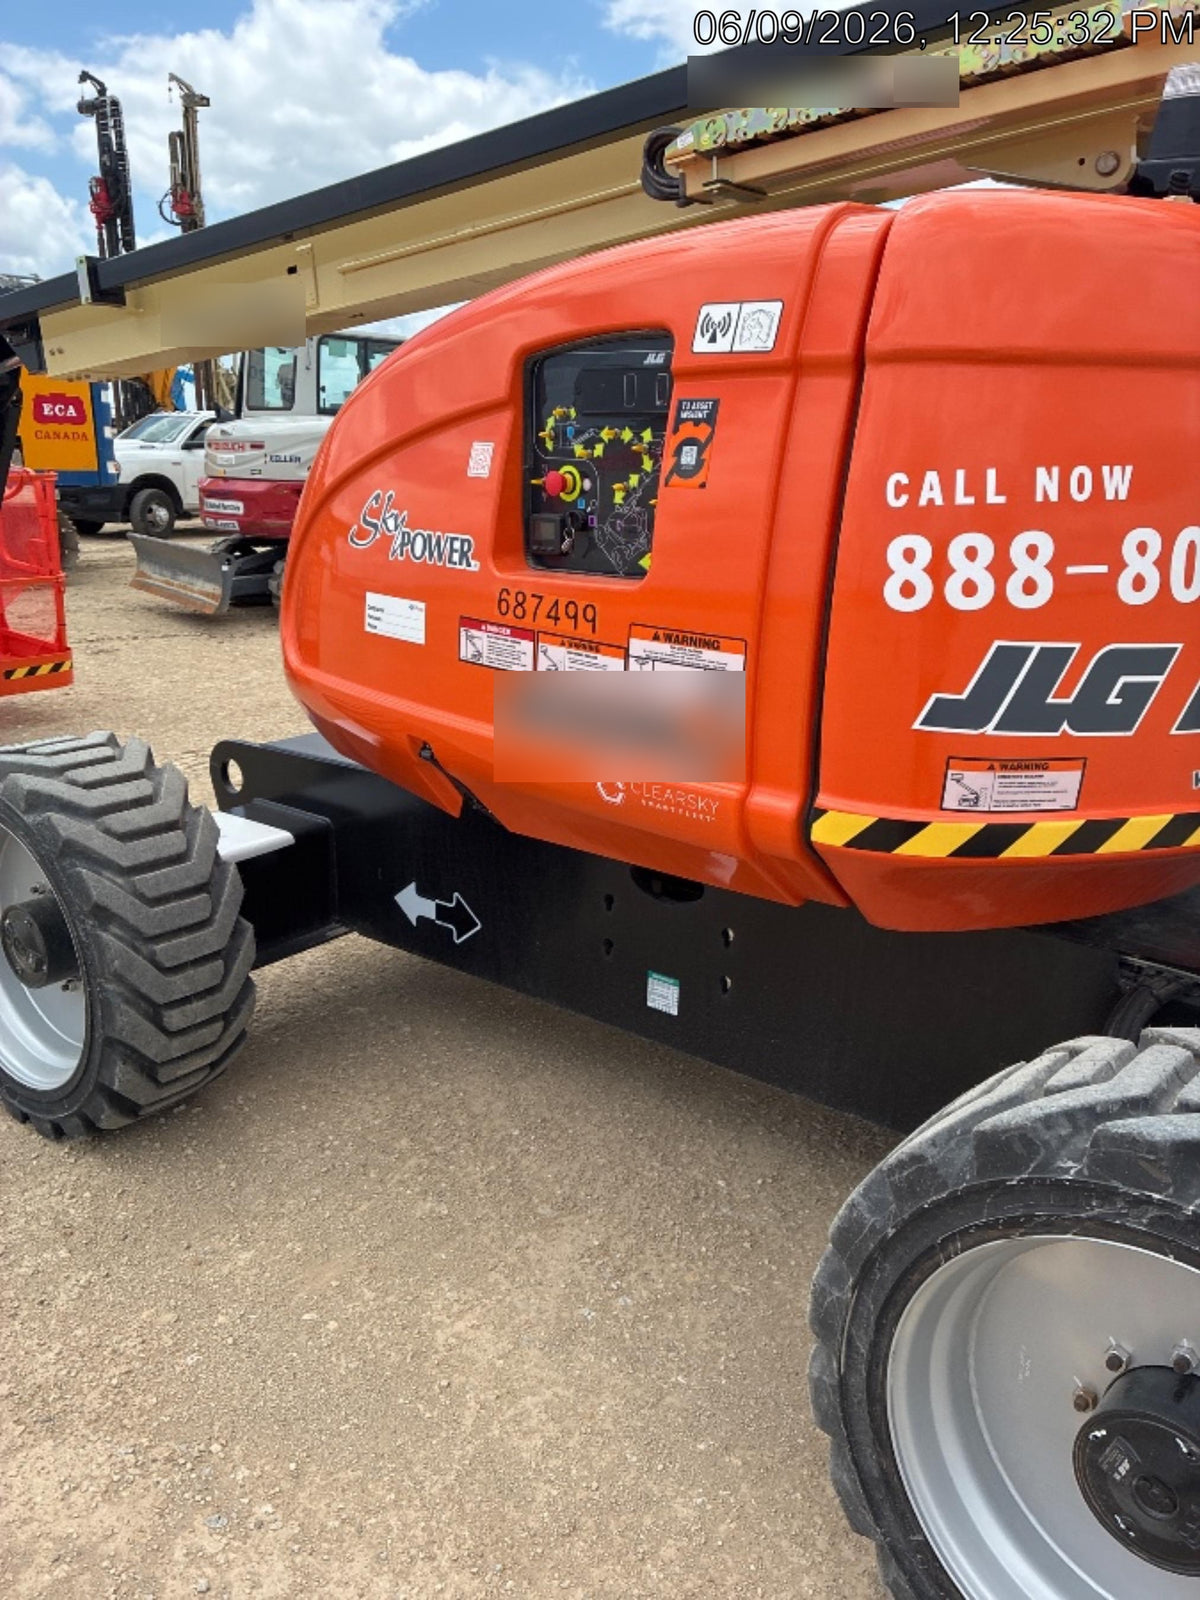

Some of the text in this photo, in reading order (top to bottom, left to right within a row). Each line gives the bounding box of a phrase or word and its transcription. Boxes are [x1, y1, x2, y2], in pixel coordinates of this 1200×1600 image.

[41, 402, 77, 417] ECA
[34, 430, 89, 441] CANADA
[885, 464, 1134, 508] CALL NOW
[496, 587, 598, 635] 687499
[662, 632, 721, 651] WARNING
[911, 640, 1184, 737] JLG
[999, 762, 1049, 771] WARNING
